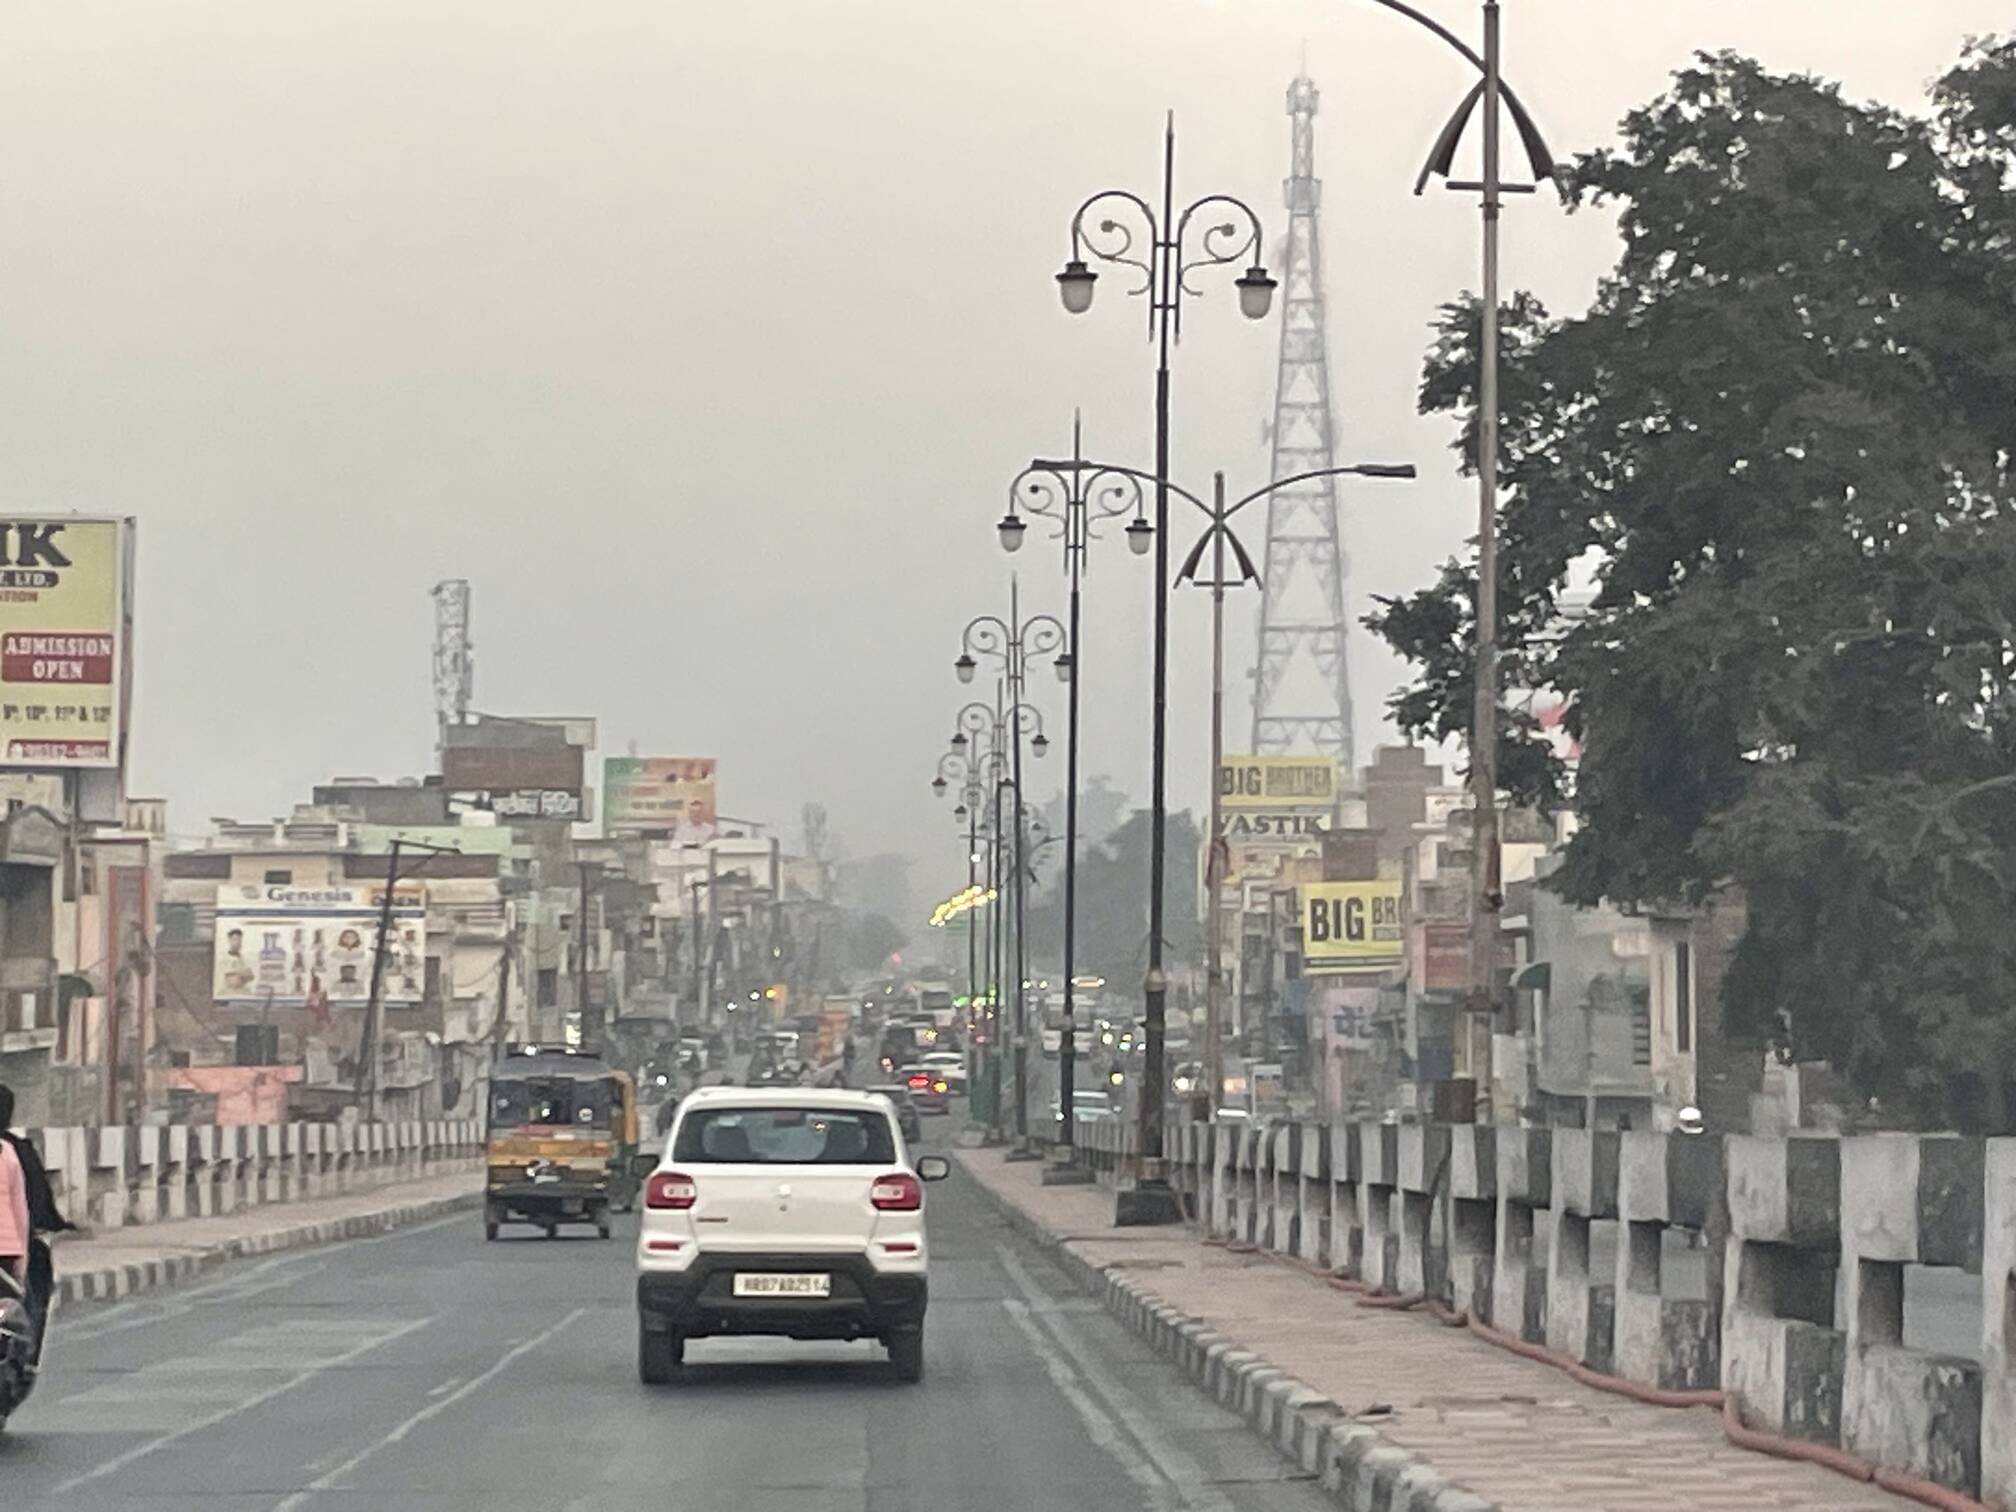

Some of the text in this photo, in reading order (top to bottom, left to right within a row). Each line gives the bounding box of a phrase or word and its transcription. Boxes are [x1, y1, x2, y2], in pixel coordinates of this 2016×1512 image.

[0, 591, 38, 602] TION
[5, 636, 112, 656] ADMISSION
[32, 659, 84, 679] OPEN
[1219, 766, 1262, 795] BIG
[267, 888, 420, 907] Genesis OEN
[1310, 897, 1365, 941] BIG
